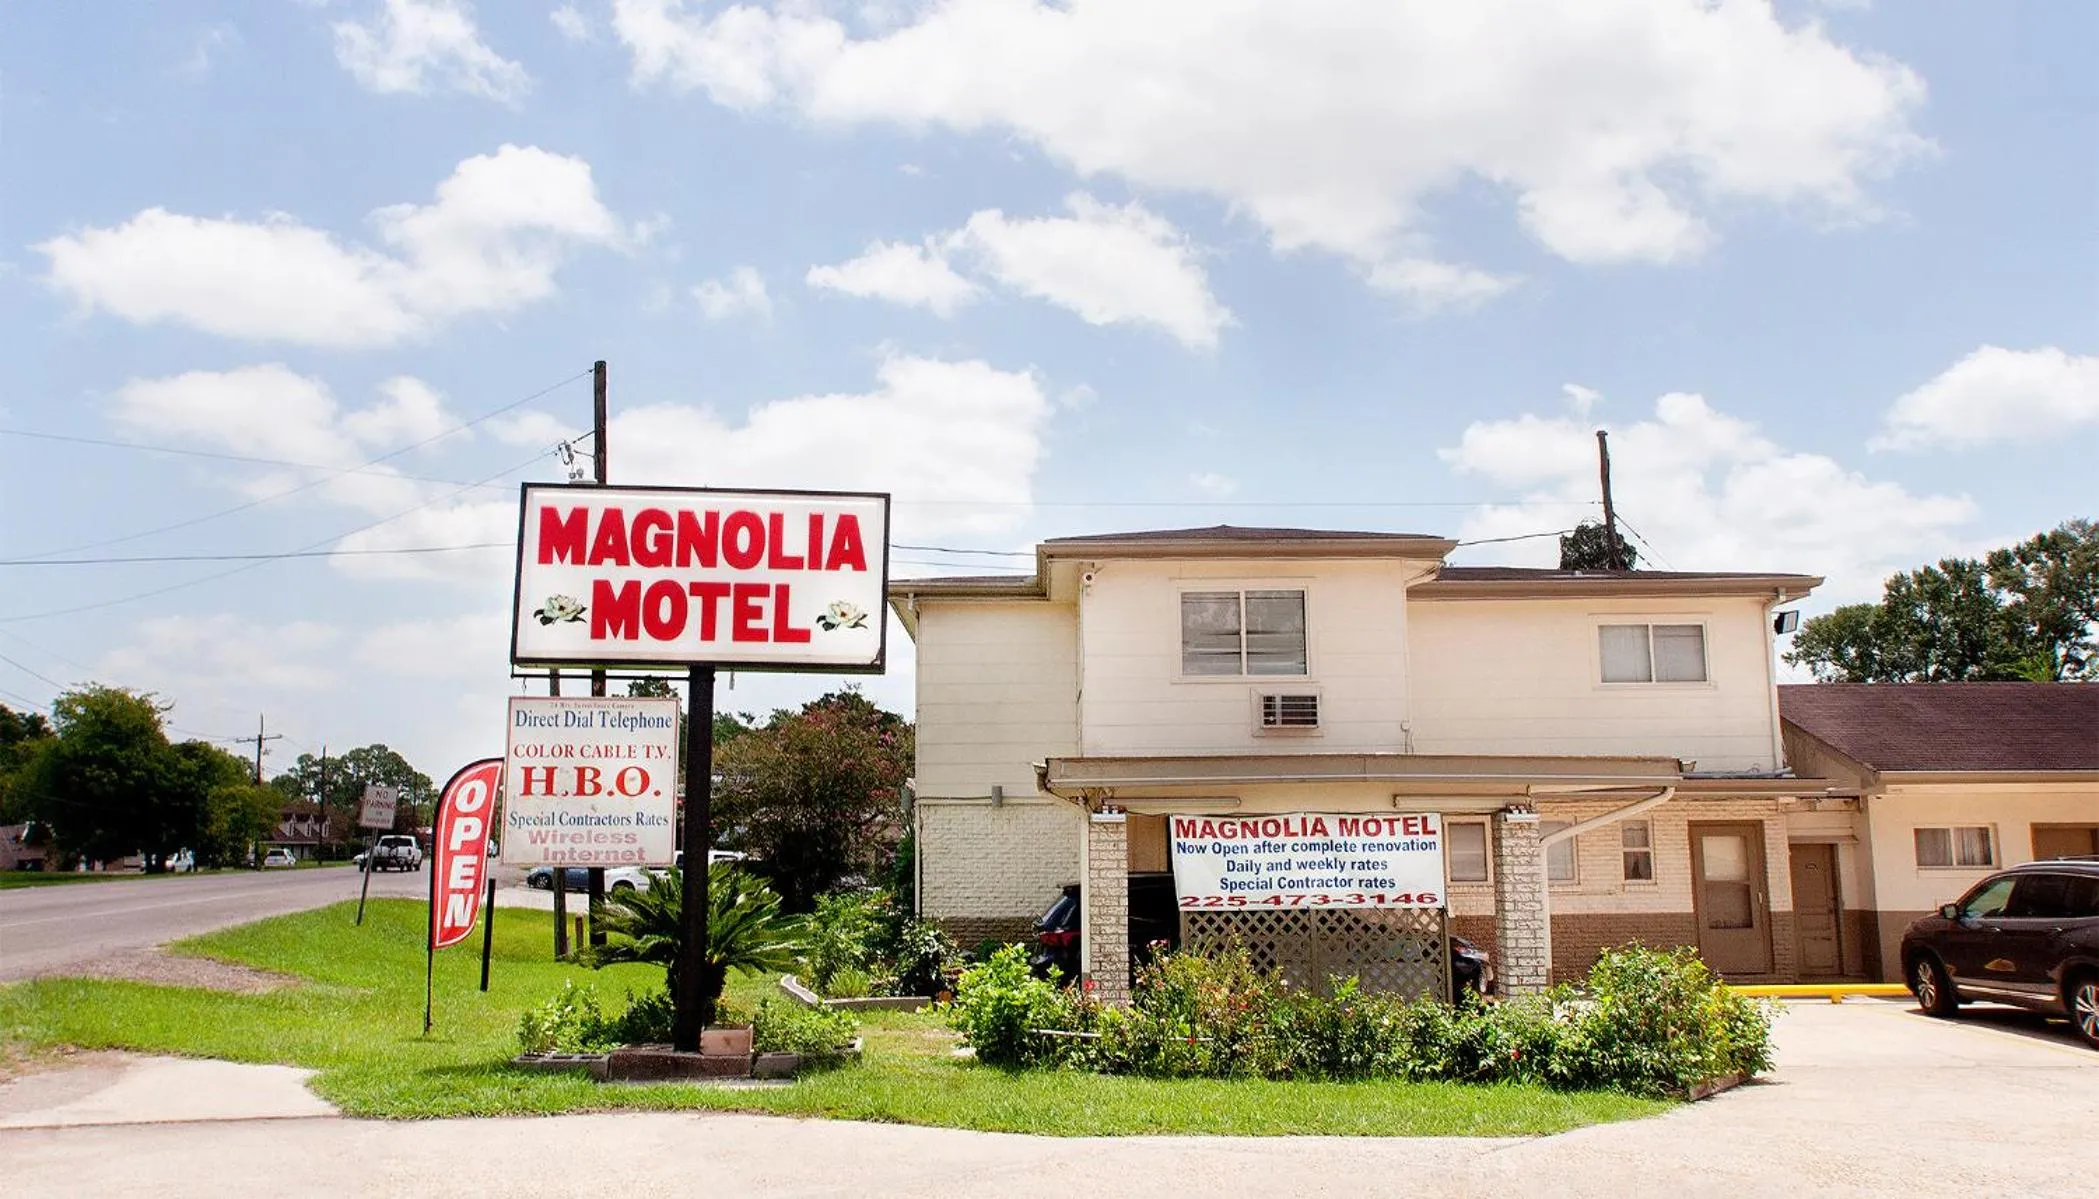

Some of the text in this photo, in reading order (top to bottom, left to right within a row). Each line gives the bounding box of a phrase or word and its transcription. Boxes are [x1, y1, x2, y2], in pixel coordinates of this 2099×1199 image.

[537, 506, 867, 571] MAGNOLIA
[590, 579, 811, 643] MOTEL
[515, 710, 672, 732] Direct Dial Telephone
[514, 743, 671, 760] COLOR CABLE T.V.
[520, 766, 661, 798] H.B.O.
[376, 790, 388, 799] NO
[509, 811, 669, 829] Special Contractors Rates
[1175, 815, 1437, 839] MAGNOLIA MOTEL
[528, 829, 638, 845] Wireless
[443, 779, 488, 928] OPEN
[543, 847, 646, 862] Internet
[1176, 838, 1437, 857] Now Open after complete renovation
[1226, 856, 1388, 875] Daily and weekly rates
[1220, 876, 1397, 892] Special Contractor rates
[1179, 892, 1439, 908] 225-473-3146
